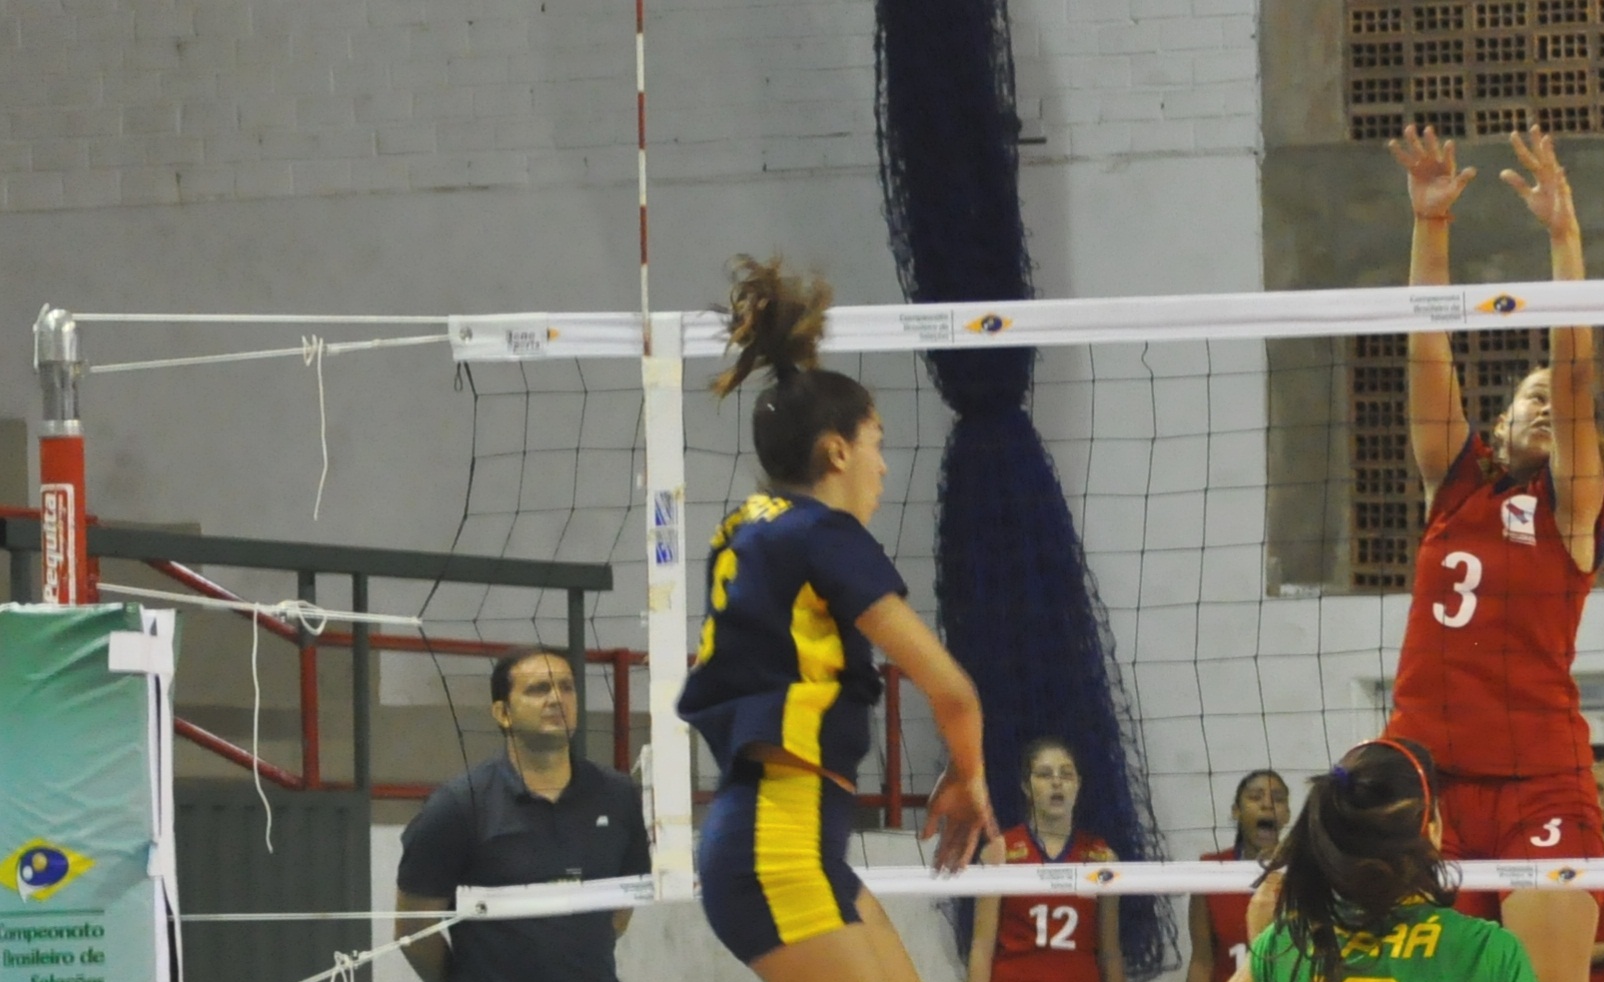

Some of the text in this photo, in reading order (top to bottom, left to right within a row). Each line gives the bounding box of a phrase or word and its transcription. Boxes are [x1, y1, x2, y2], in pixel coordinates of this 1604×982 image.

[1432, 551, 1483, 628] 3
[1028, 903, 1079, 951] 12
[1307, 915, 1442, 959] ARÁ
[3, 946, 105, 967] Brasileiro de
